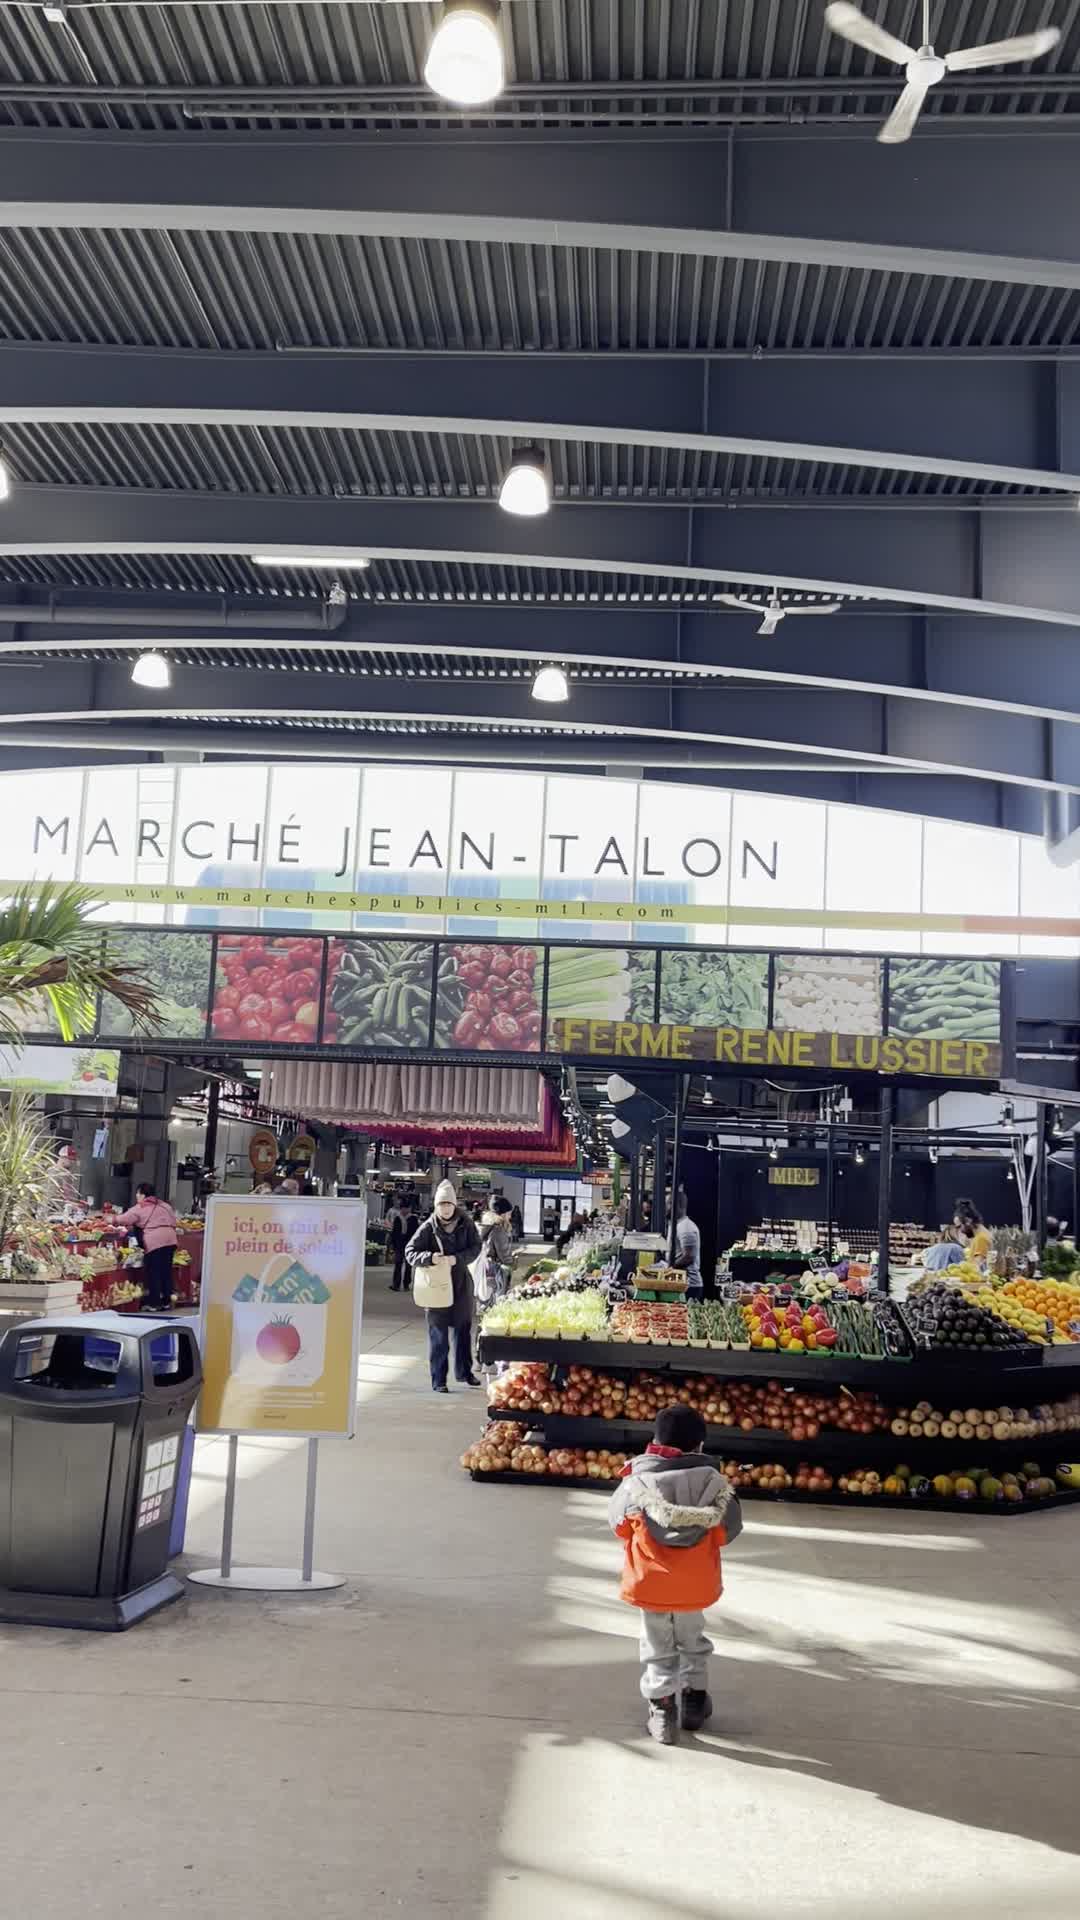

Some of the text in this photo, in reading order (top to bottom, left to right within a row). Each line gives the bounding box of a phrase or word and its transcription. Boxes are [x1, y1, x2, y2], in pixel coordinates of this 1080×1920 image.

[33, 813, 302, 864] MARCHÉ
[561, 1020, 989, 1076] FERME RENE LUSSIER
[773, 1167, 817, 1186] MIEL
[232, 1216, 258, 1235] ici,
[262, 1221, 284, 1234] on
[322, 1219, 339, 1235] le
[224, 1236, 269, 1256] plein
[272, 1238, 293, 1254] de
